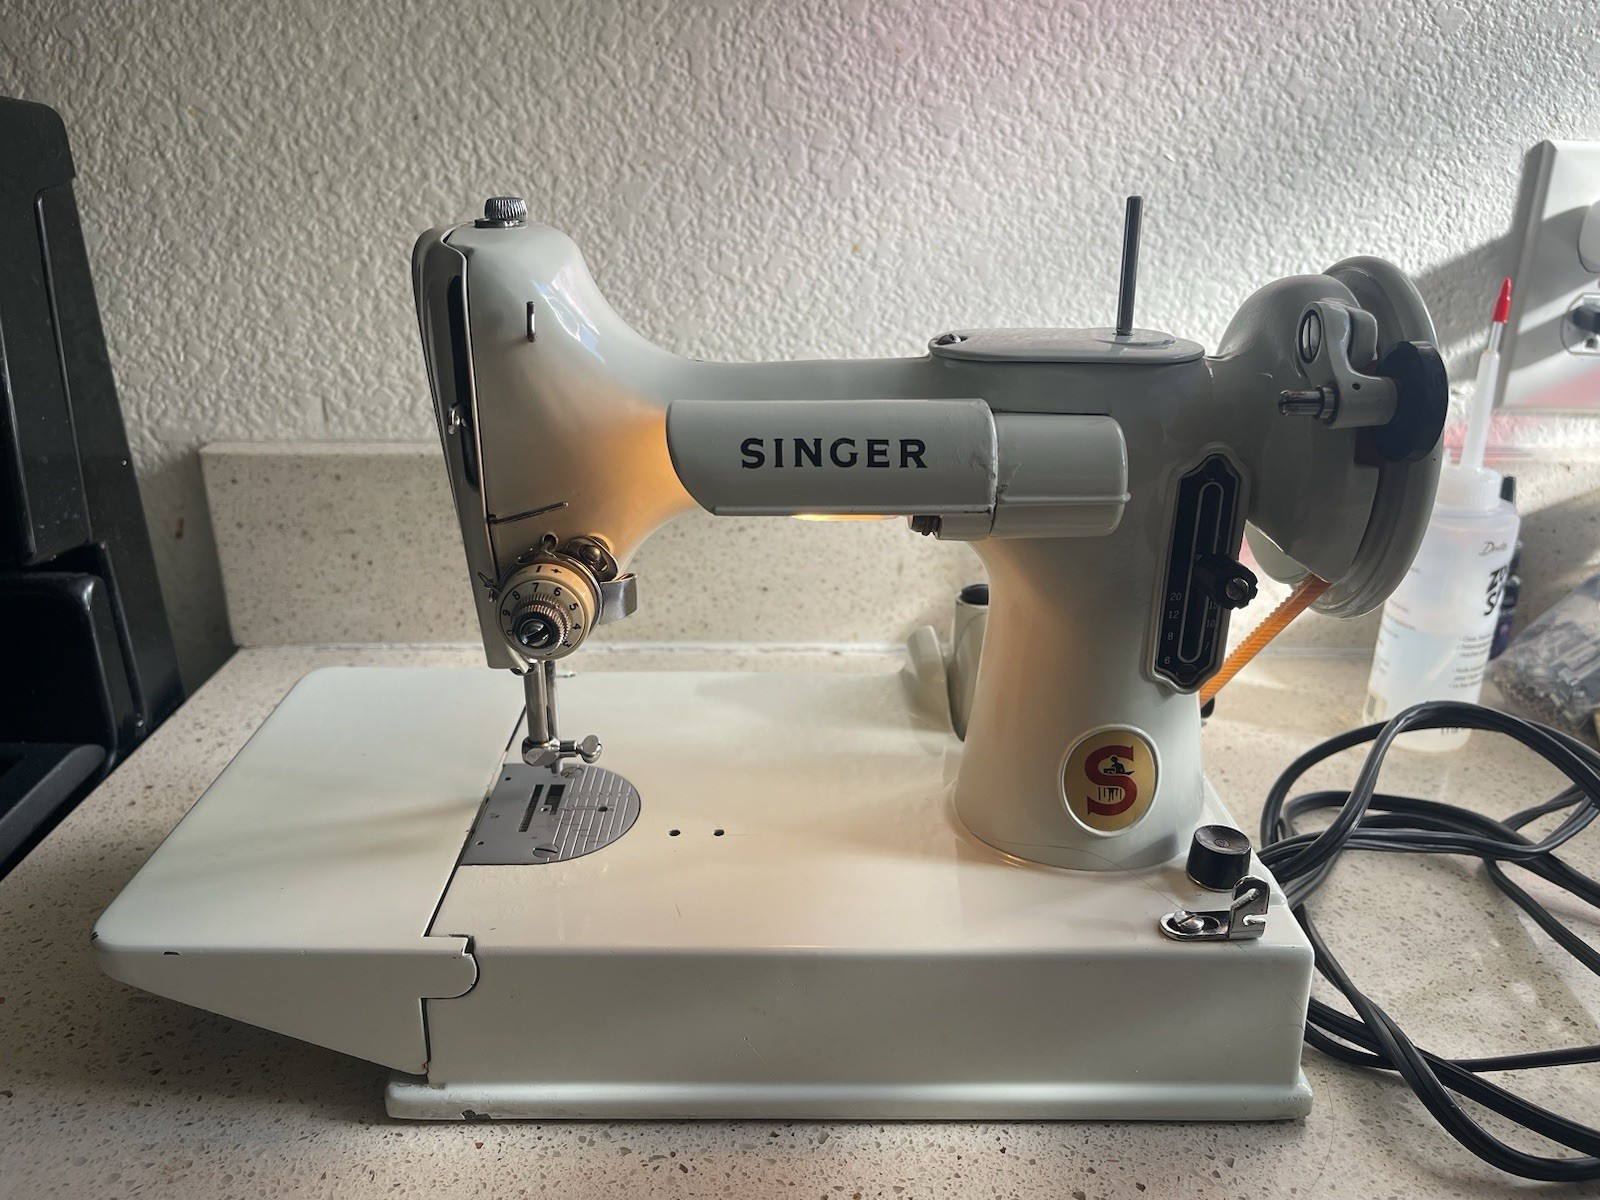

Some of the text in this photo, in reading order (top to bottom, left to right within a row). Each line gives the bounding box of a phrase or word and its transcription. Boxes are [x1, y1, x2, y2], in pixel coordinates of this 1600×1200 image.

[740, 437, 928, 469] SINGER
[532, 582, 540, 592] 7
[512, 590, 521, 600] 8
[553, 587, 563, 597] 6
[1169, 592, 1182, 602] 20
[569, 602, 579, 611] 5
[1168, 610, 1180, 619] 12
[572, 622, 582, 630] 4
[1167, 632, 1174, 641] 8
[562, 640, 573, 648] 3
[1164, 656, 1171, 665] 6
[1084, 745, 1138, 817] S
